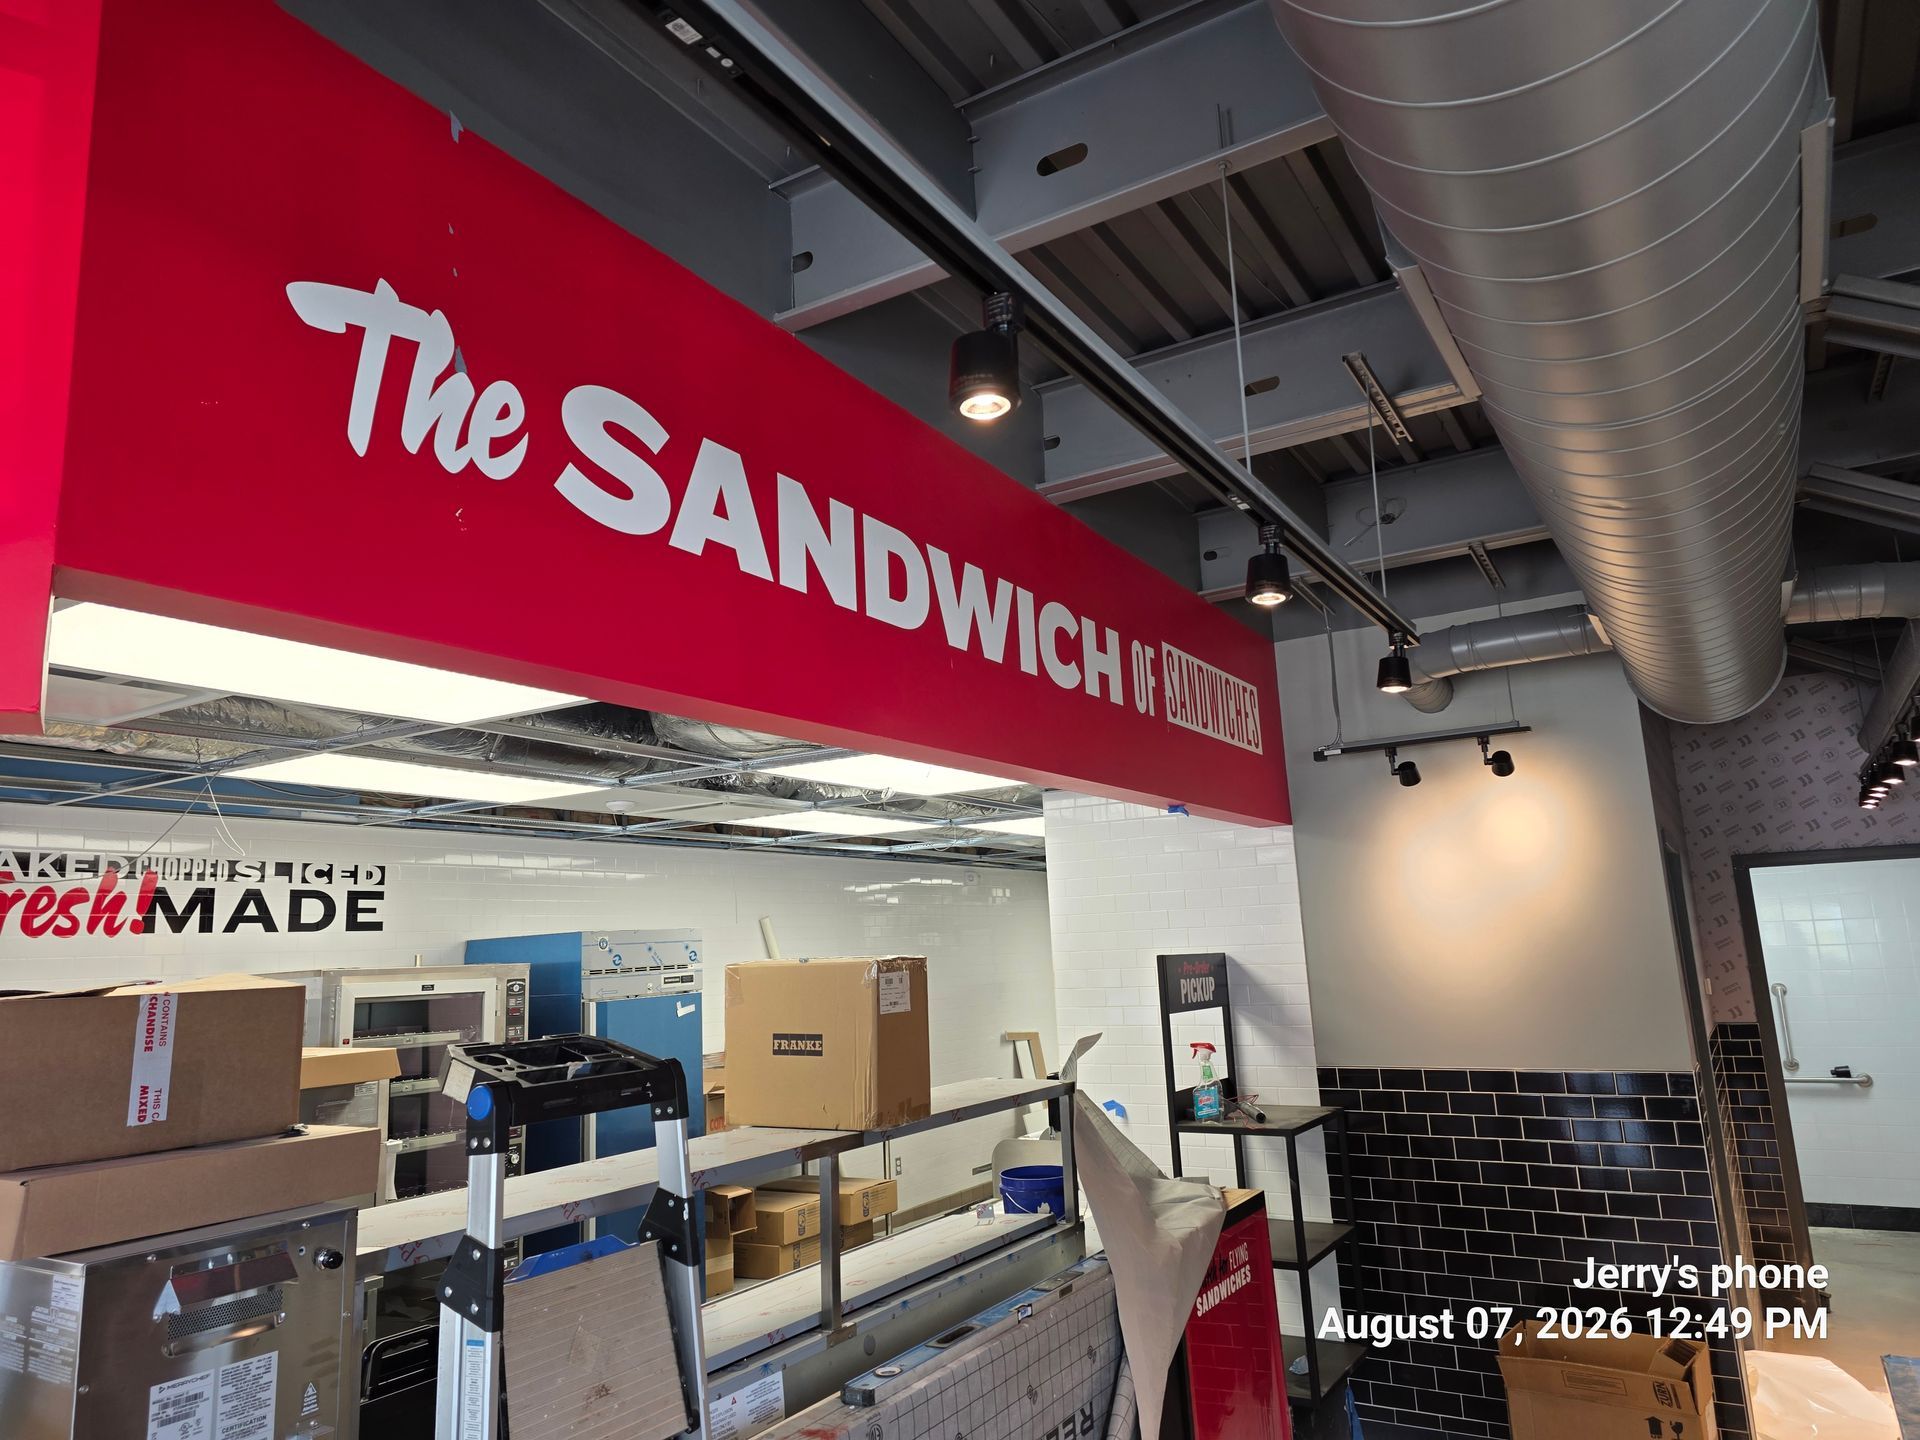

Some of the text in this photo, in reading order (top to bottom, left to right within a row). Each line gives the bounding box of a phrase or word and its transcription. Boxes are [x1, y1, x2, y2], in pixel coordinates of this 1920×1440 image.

[286, 278, 1260, 750] The SANDWICH OF SANDWICHES
[135, 857, 229, 882] CHOPPED
[235, 860, 382, 885] SLICED
[0, 867, 385, 938] resh! MADE
[1180, 977, 1215, 1004] PICKUP
[144, 993, 159, 1052] CHANDISE
[159, 999, 171, 1047] CONTAINS
[773, 1039, 822, 1050] FRANKE
[137, 1085, 149, 1123] MIXED
[152, 1088, 162, 1110] THIS
[1229, 1242, 1249, 1271] FLYING
[1196, 1264, 1252, 1317] SANDWICHES
[221, 1415, 267, 1434] CERTIFICATION
